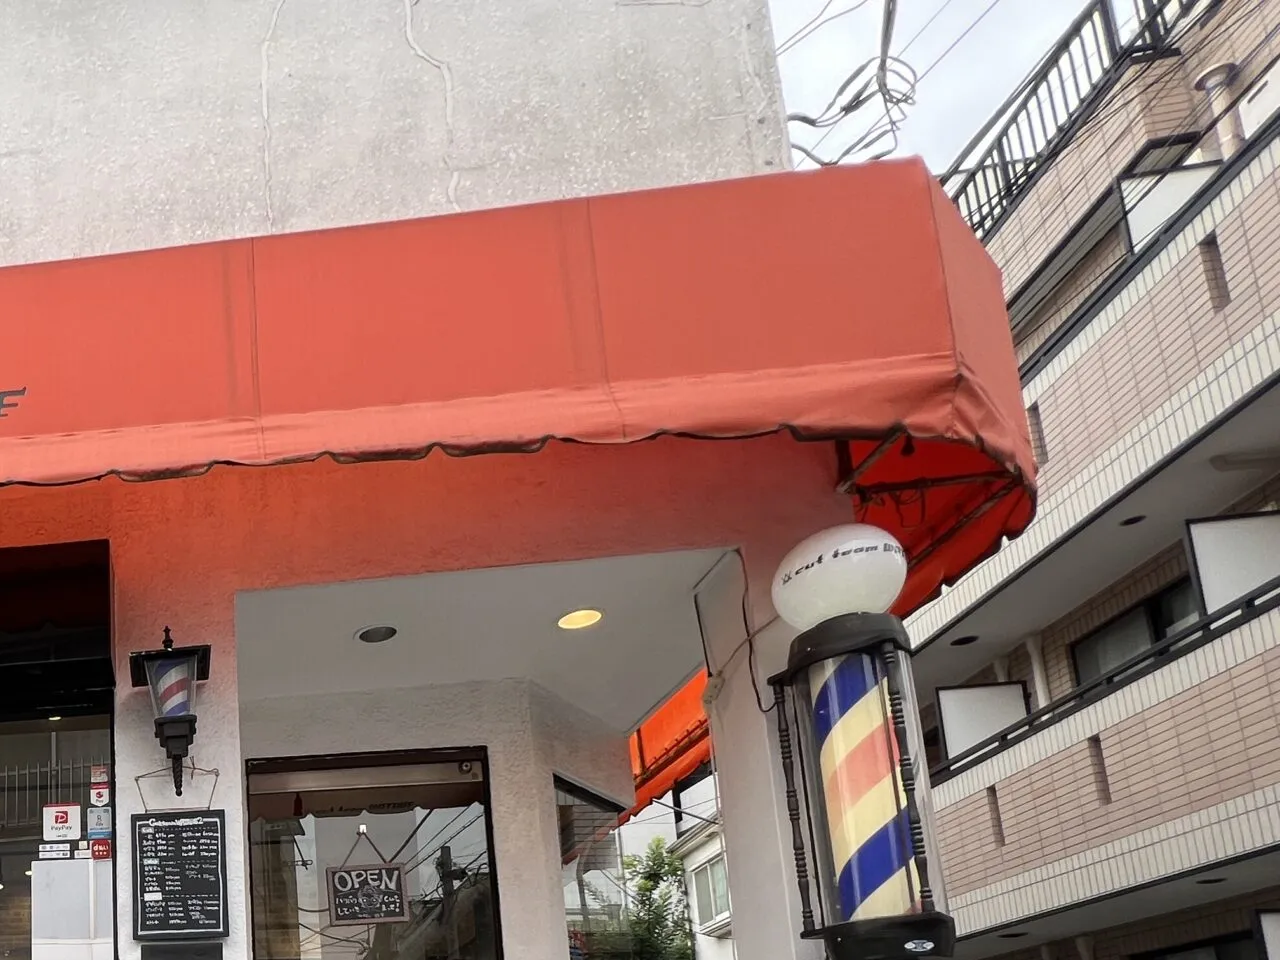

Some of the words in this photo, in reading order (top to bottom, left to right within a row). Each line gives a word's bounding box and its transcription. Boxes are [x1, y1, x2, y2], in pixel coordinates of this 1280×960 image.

[795, 553, 823, 576] cut
[832, 544, 878, 559] team
[334, 869, 399, 891] OPEN
